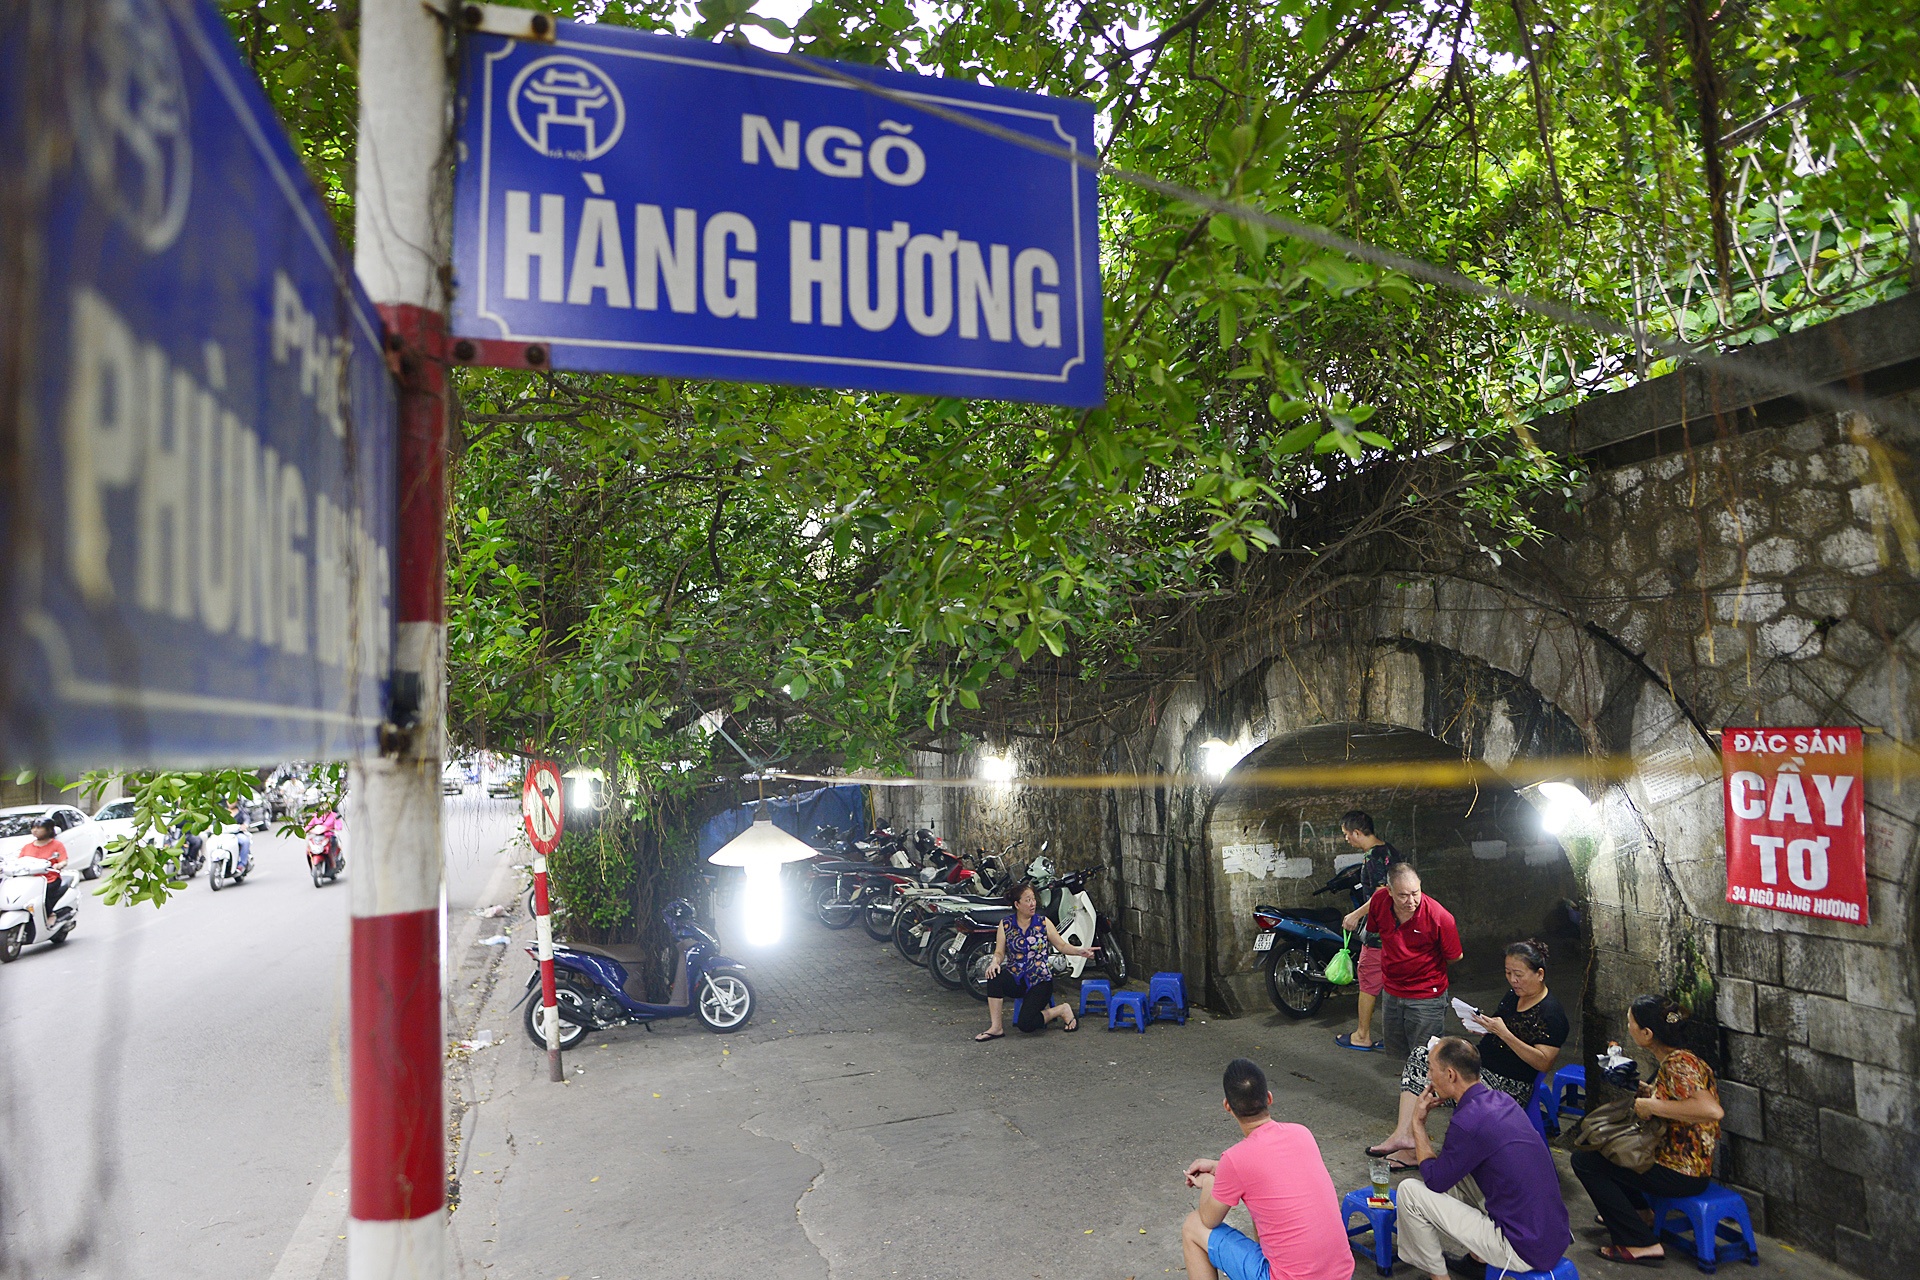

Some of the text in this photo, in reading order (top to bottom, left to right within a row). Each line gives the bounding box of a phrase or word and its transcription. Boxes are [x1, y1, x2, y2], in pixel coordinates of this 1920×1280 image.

[742, 113, 927, 187] NGÕ
[504, 172, 1062, 350] HÀNG HƯƠNG
[1733, 728, 1847, 758] ĐẶC SẢN
[1730, 756, 1854, 827] CẦY
[1750, 834, 1831, 891] TƠ
[1732, 885, 1860, 921] 34 NGÕ HÀNG HƯƠNG
